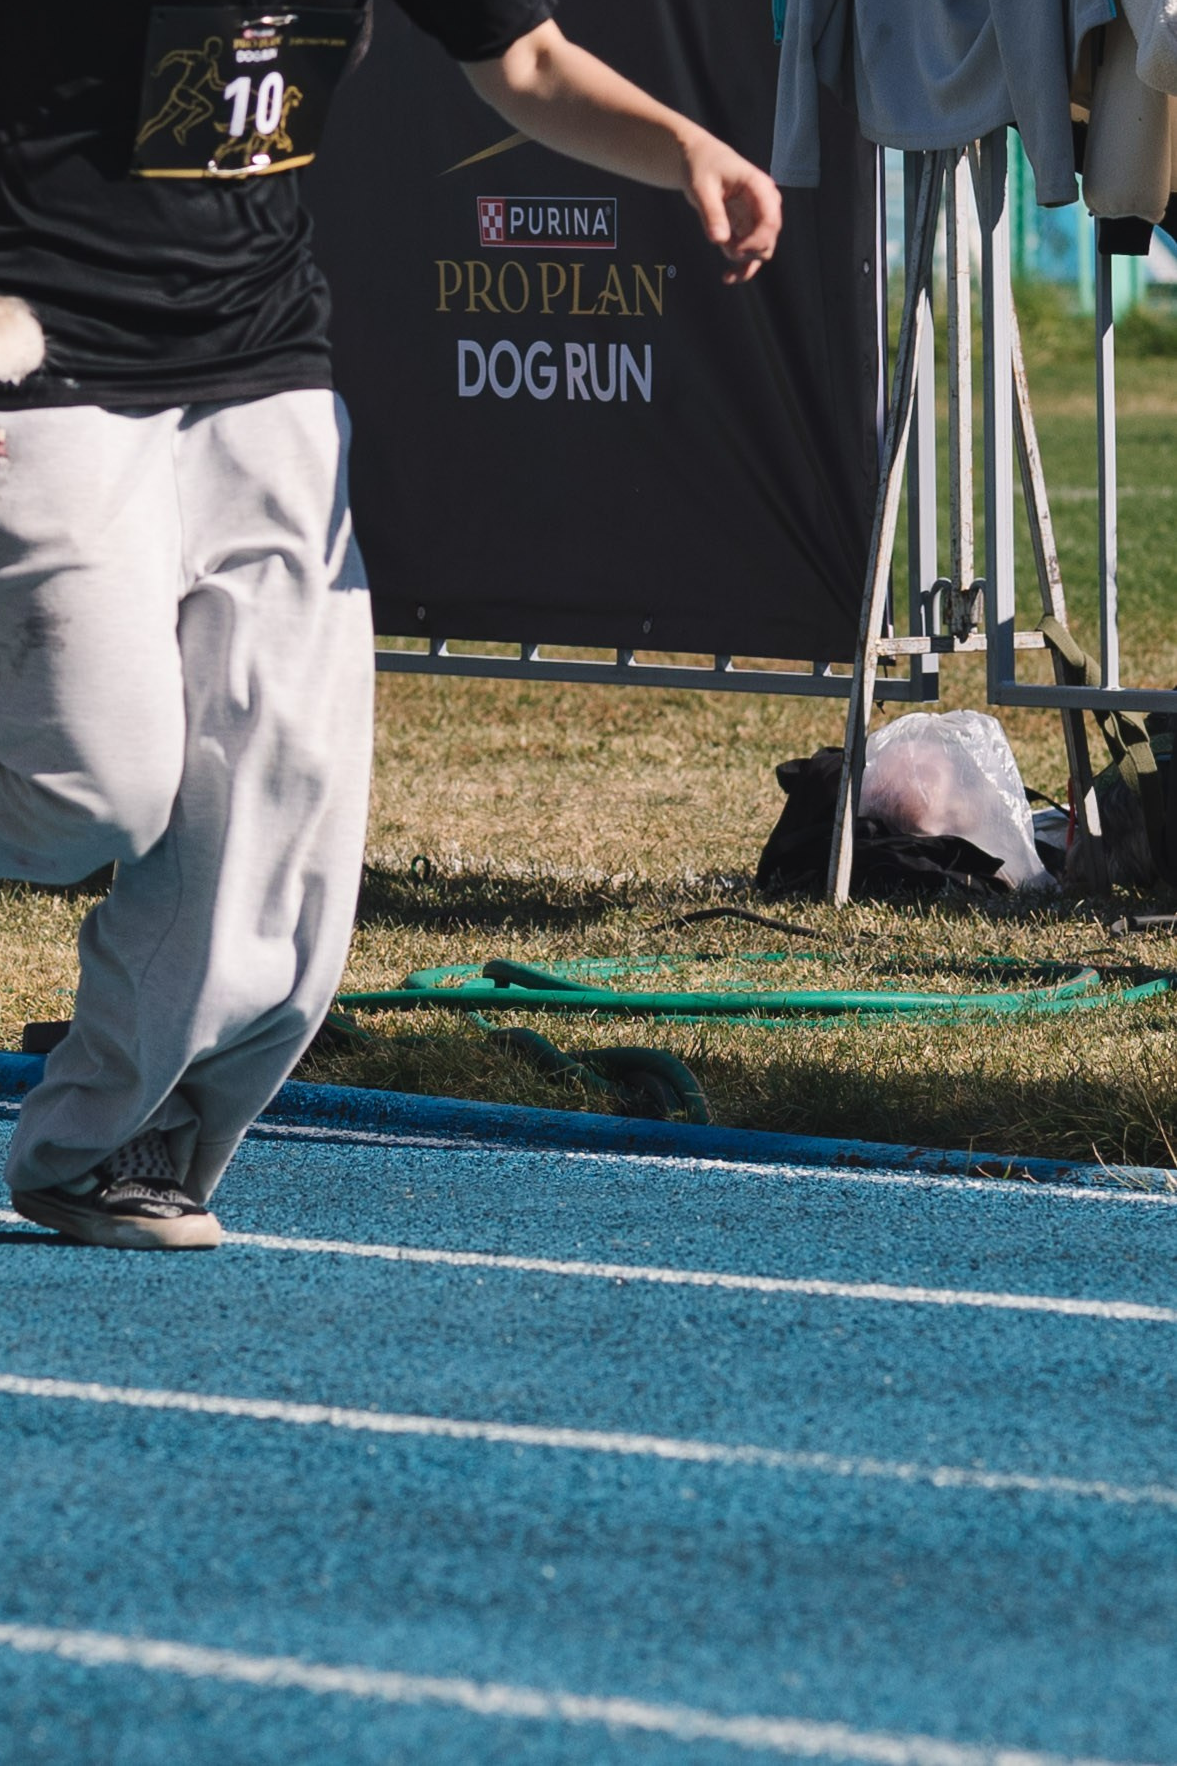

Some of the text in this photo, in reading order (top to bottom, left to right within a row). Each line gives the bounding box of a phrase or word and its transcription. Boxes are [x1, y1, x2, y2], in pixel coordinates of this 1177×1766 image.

[224, 71, 284, 137] 10
[509, 206, 609, 236] PURINA
[434, 259, 530, 314] PRO
[457, 339, 653, 403] DOG RUN
